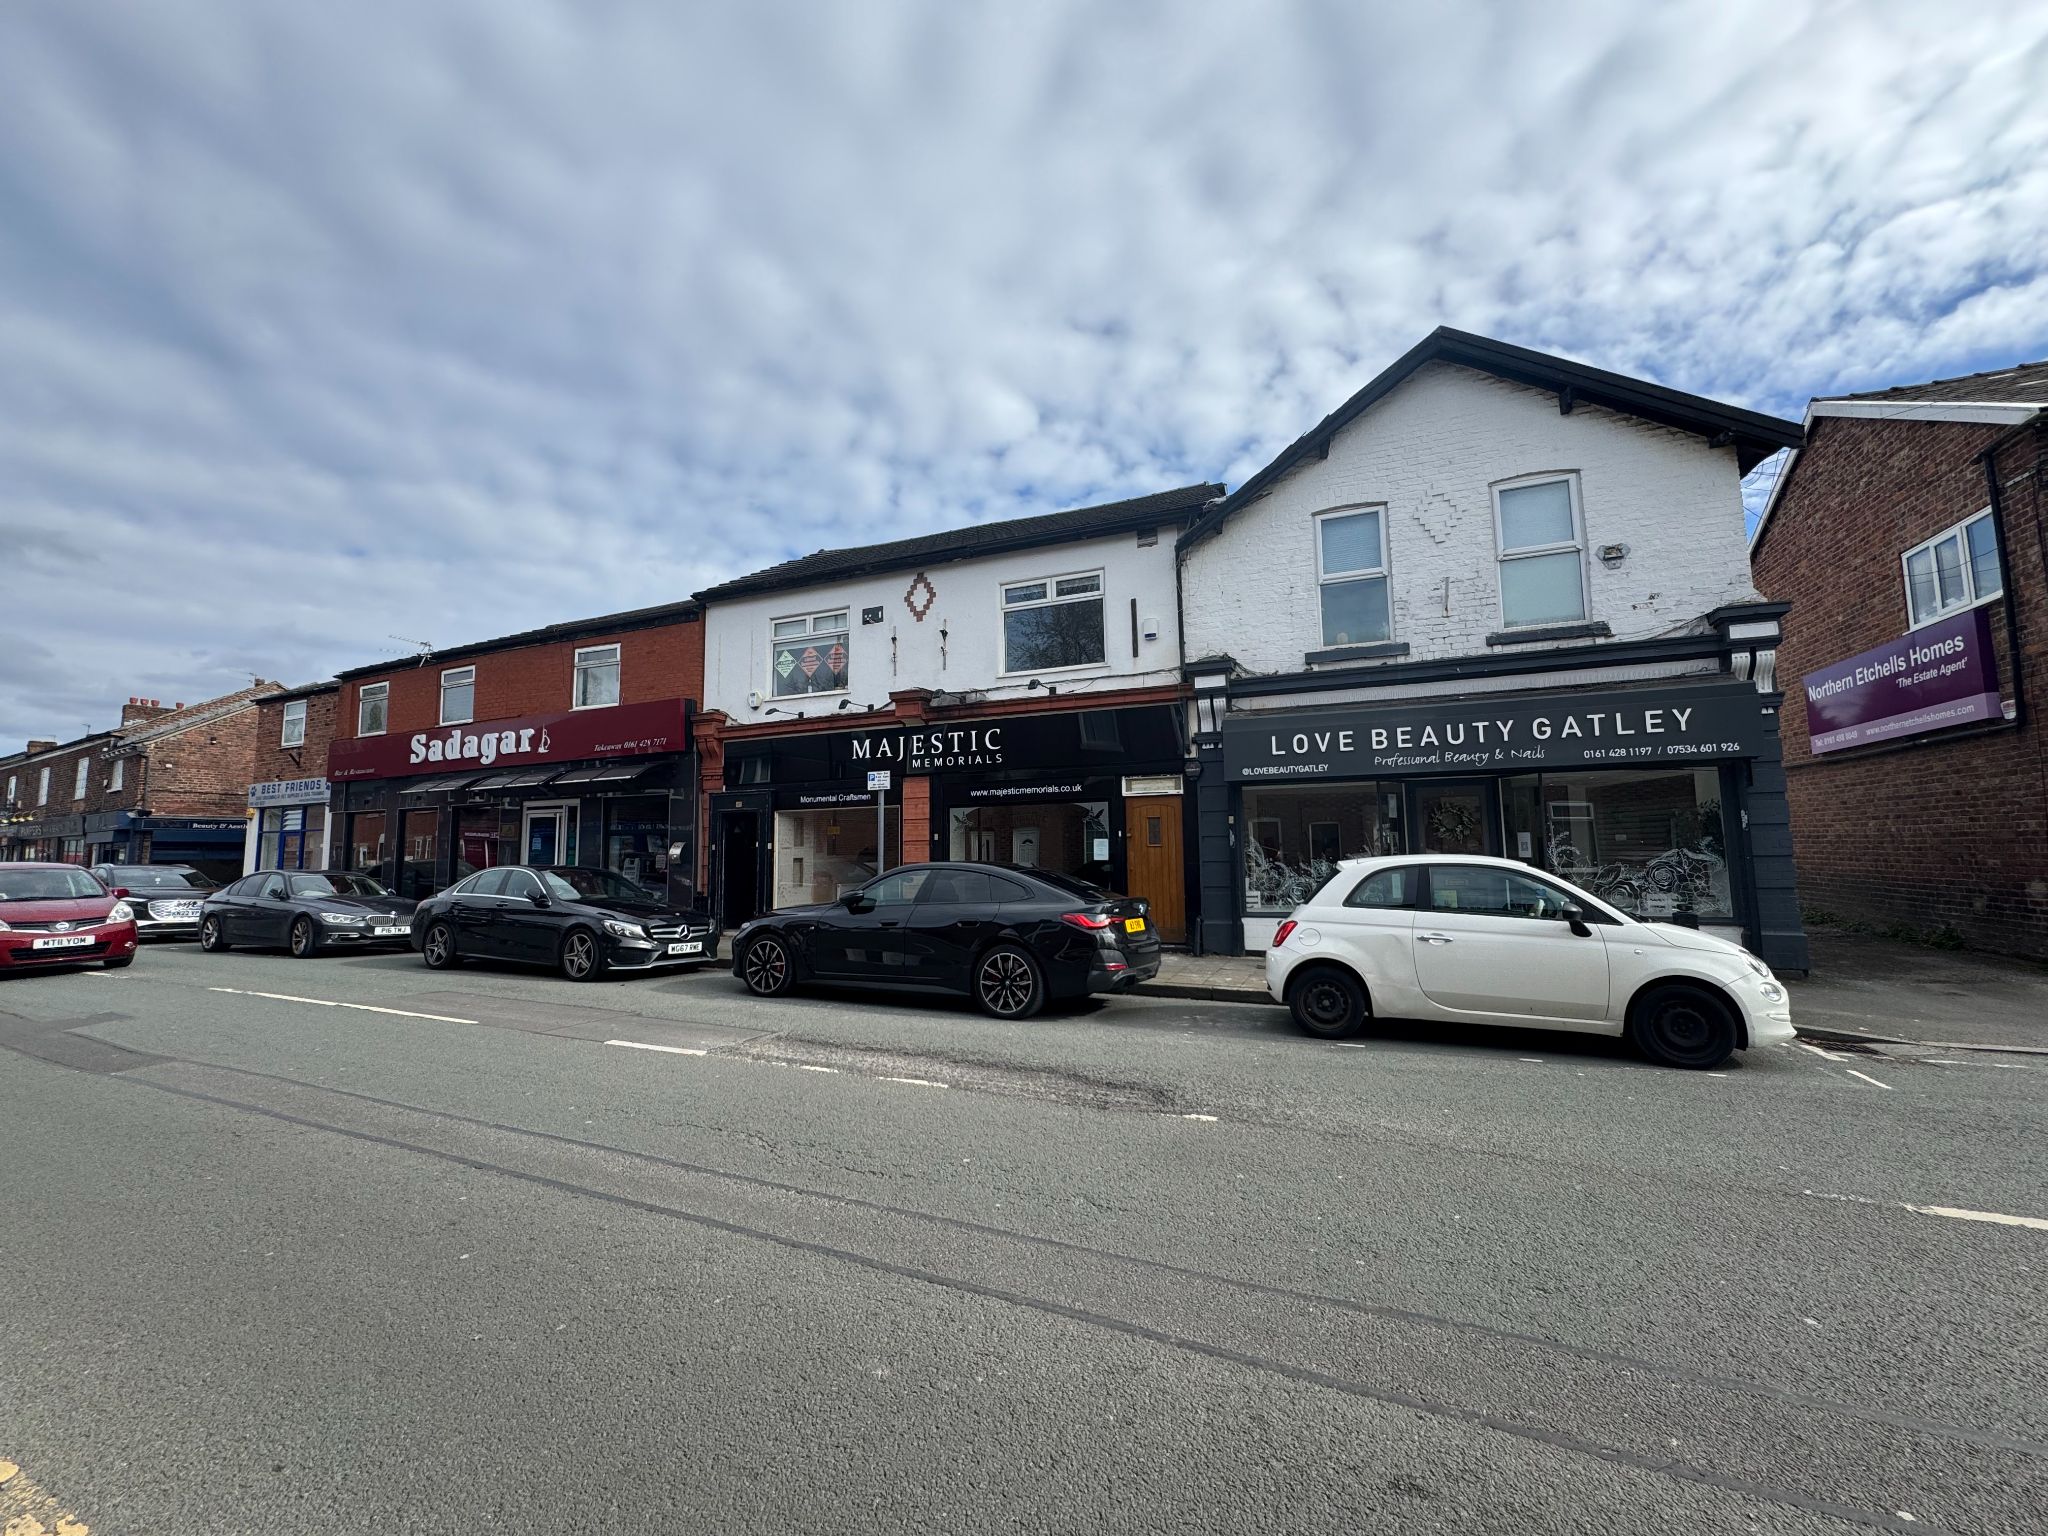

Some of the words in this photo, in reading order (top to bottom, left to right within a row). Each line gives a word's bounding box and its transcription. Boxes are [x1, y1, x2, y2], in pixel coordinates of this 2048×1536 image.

[1808, 676, 1854, 703] Northern
[1855, 655, 1907, 687] Etchells
[1909, 635, 1965, 668] Homes
[1913, 667, 1938, 684] Estate
[1271, 730, 1355, 755] LOVE
[1371, 719, 1514, 750] BEAUTY
[1532, 707, 1693, 740] GATLEY
[410, 728, 535, 765] Sadagar
[623, 740, 638, 749] 0161
[639, 739, 652, 747] 428
[653, 737, 667, 745] 7171
[851, 728, 1001, 762] MAJESTIC
[1583, 749, 1606, 759] 0161
[1608, 748, 1627, 757] 428
[1629, 747, 1652, 756] 1197
[1667, 745, 1698, 754] 07534
[1700, 744, 1718, 753] 601
[1720, 742, 1740, 751] 926
[912, 743, 1003, 768] MEMORIALS
[1374, 750, 1440, 768] Professional
[1444, 751, 1490, 766] Beauty
[1494, 748, 1504, 760] &
[1511, 745, 1546, 759] Nails
[1242, 764, 1329, 776] @LOVEBEAUTYGATLEY
[261, 783, 281, 795] BEST
[285, 780, 321, 793] FRIENDS
[970, 784, 1082, 797] www.majesticmemorials.co.uk
[800, 794, 838, 803] Monumental
[838, 793, 871, 802] Craftsmen
